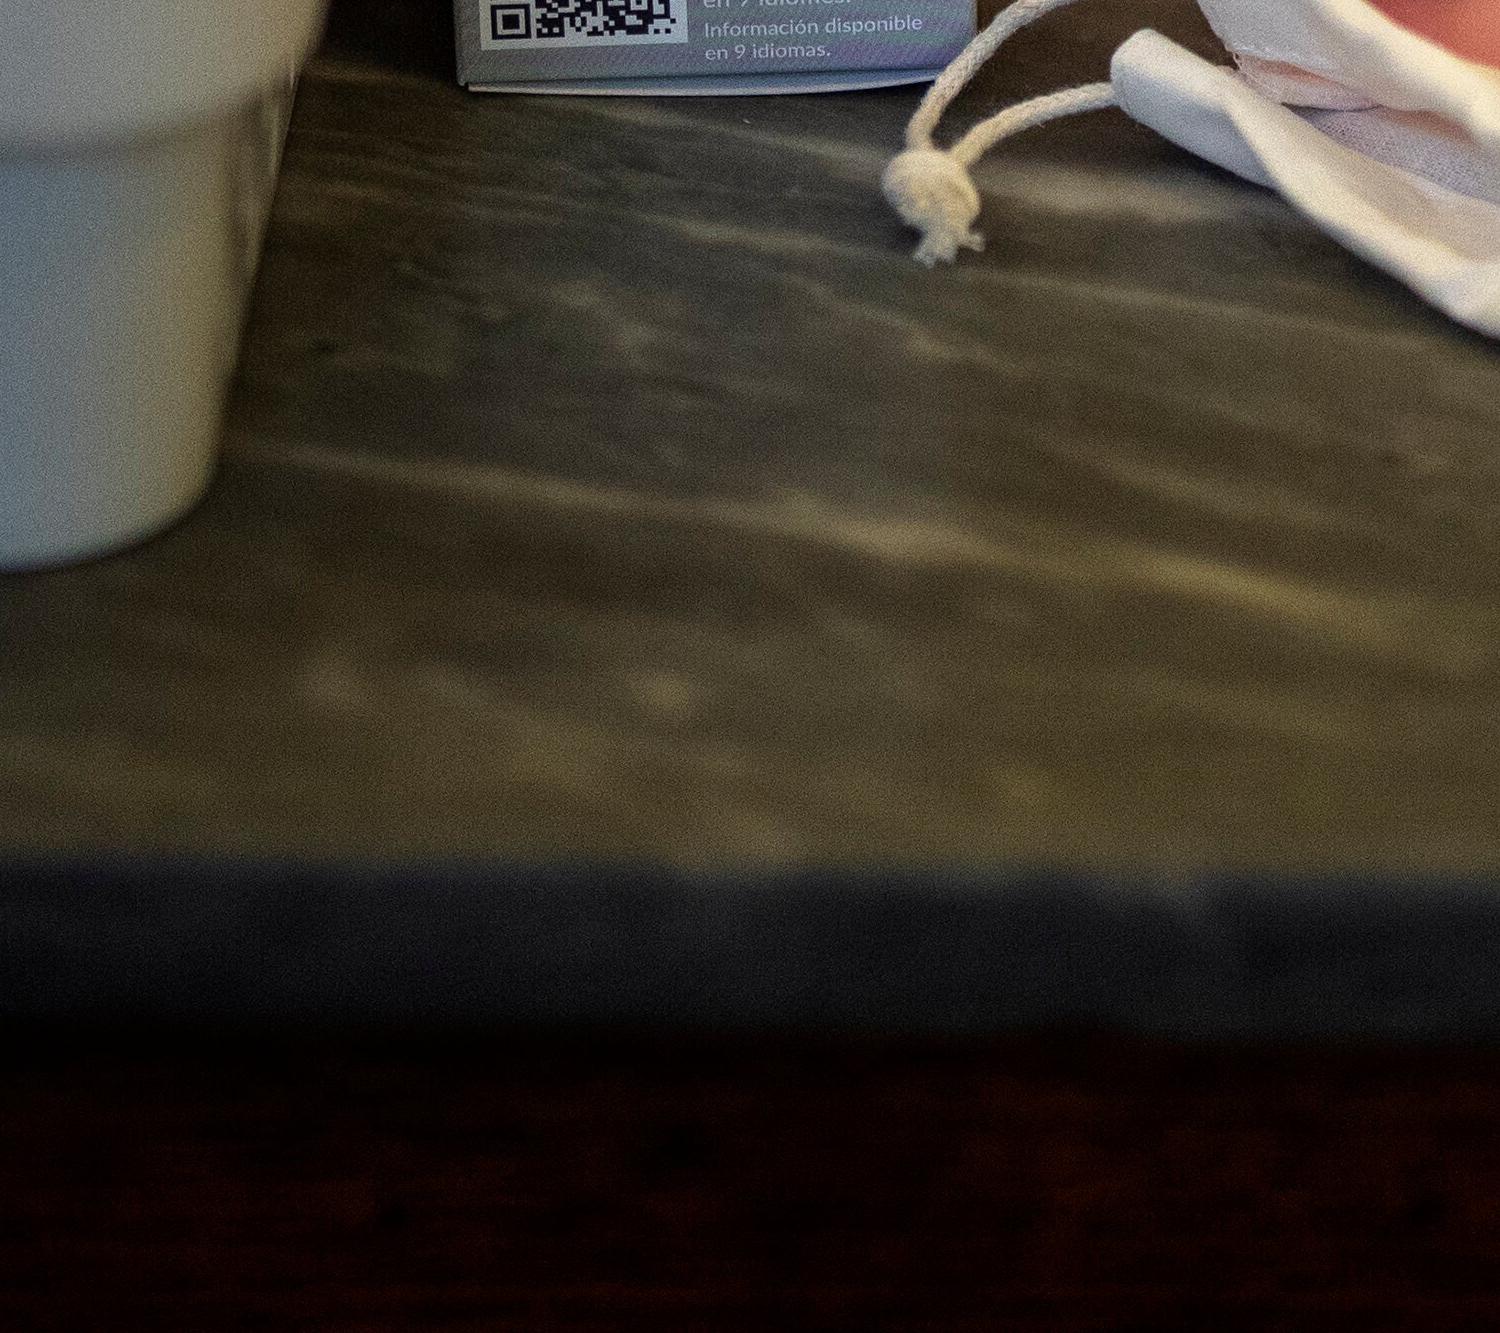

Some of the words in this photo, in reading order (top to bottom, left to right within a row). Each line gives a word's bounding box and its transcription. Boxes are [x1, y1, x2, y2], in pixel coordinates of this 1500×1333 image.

[704, 19, 819, 39] Información
[824, 15, 923, 35] disponible
[705, 44, 729, 60] en
[735, 43, 745, 60] 9
[752, 42, 831, 60] idiomas.
